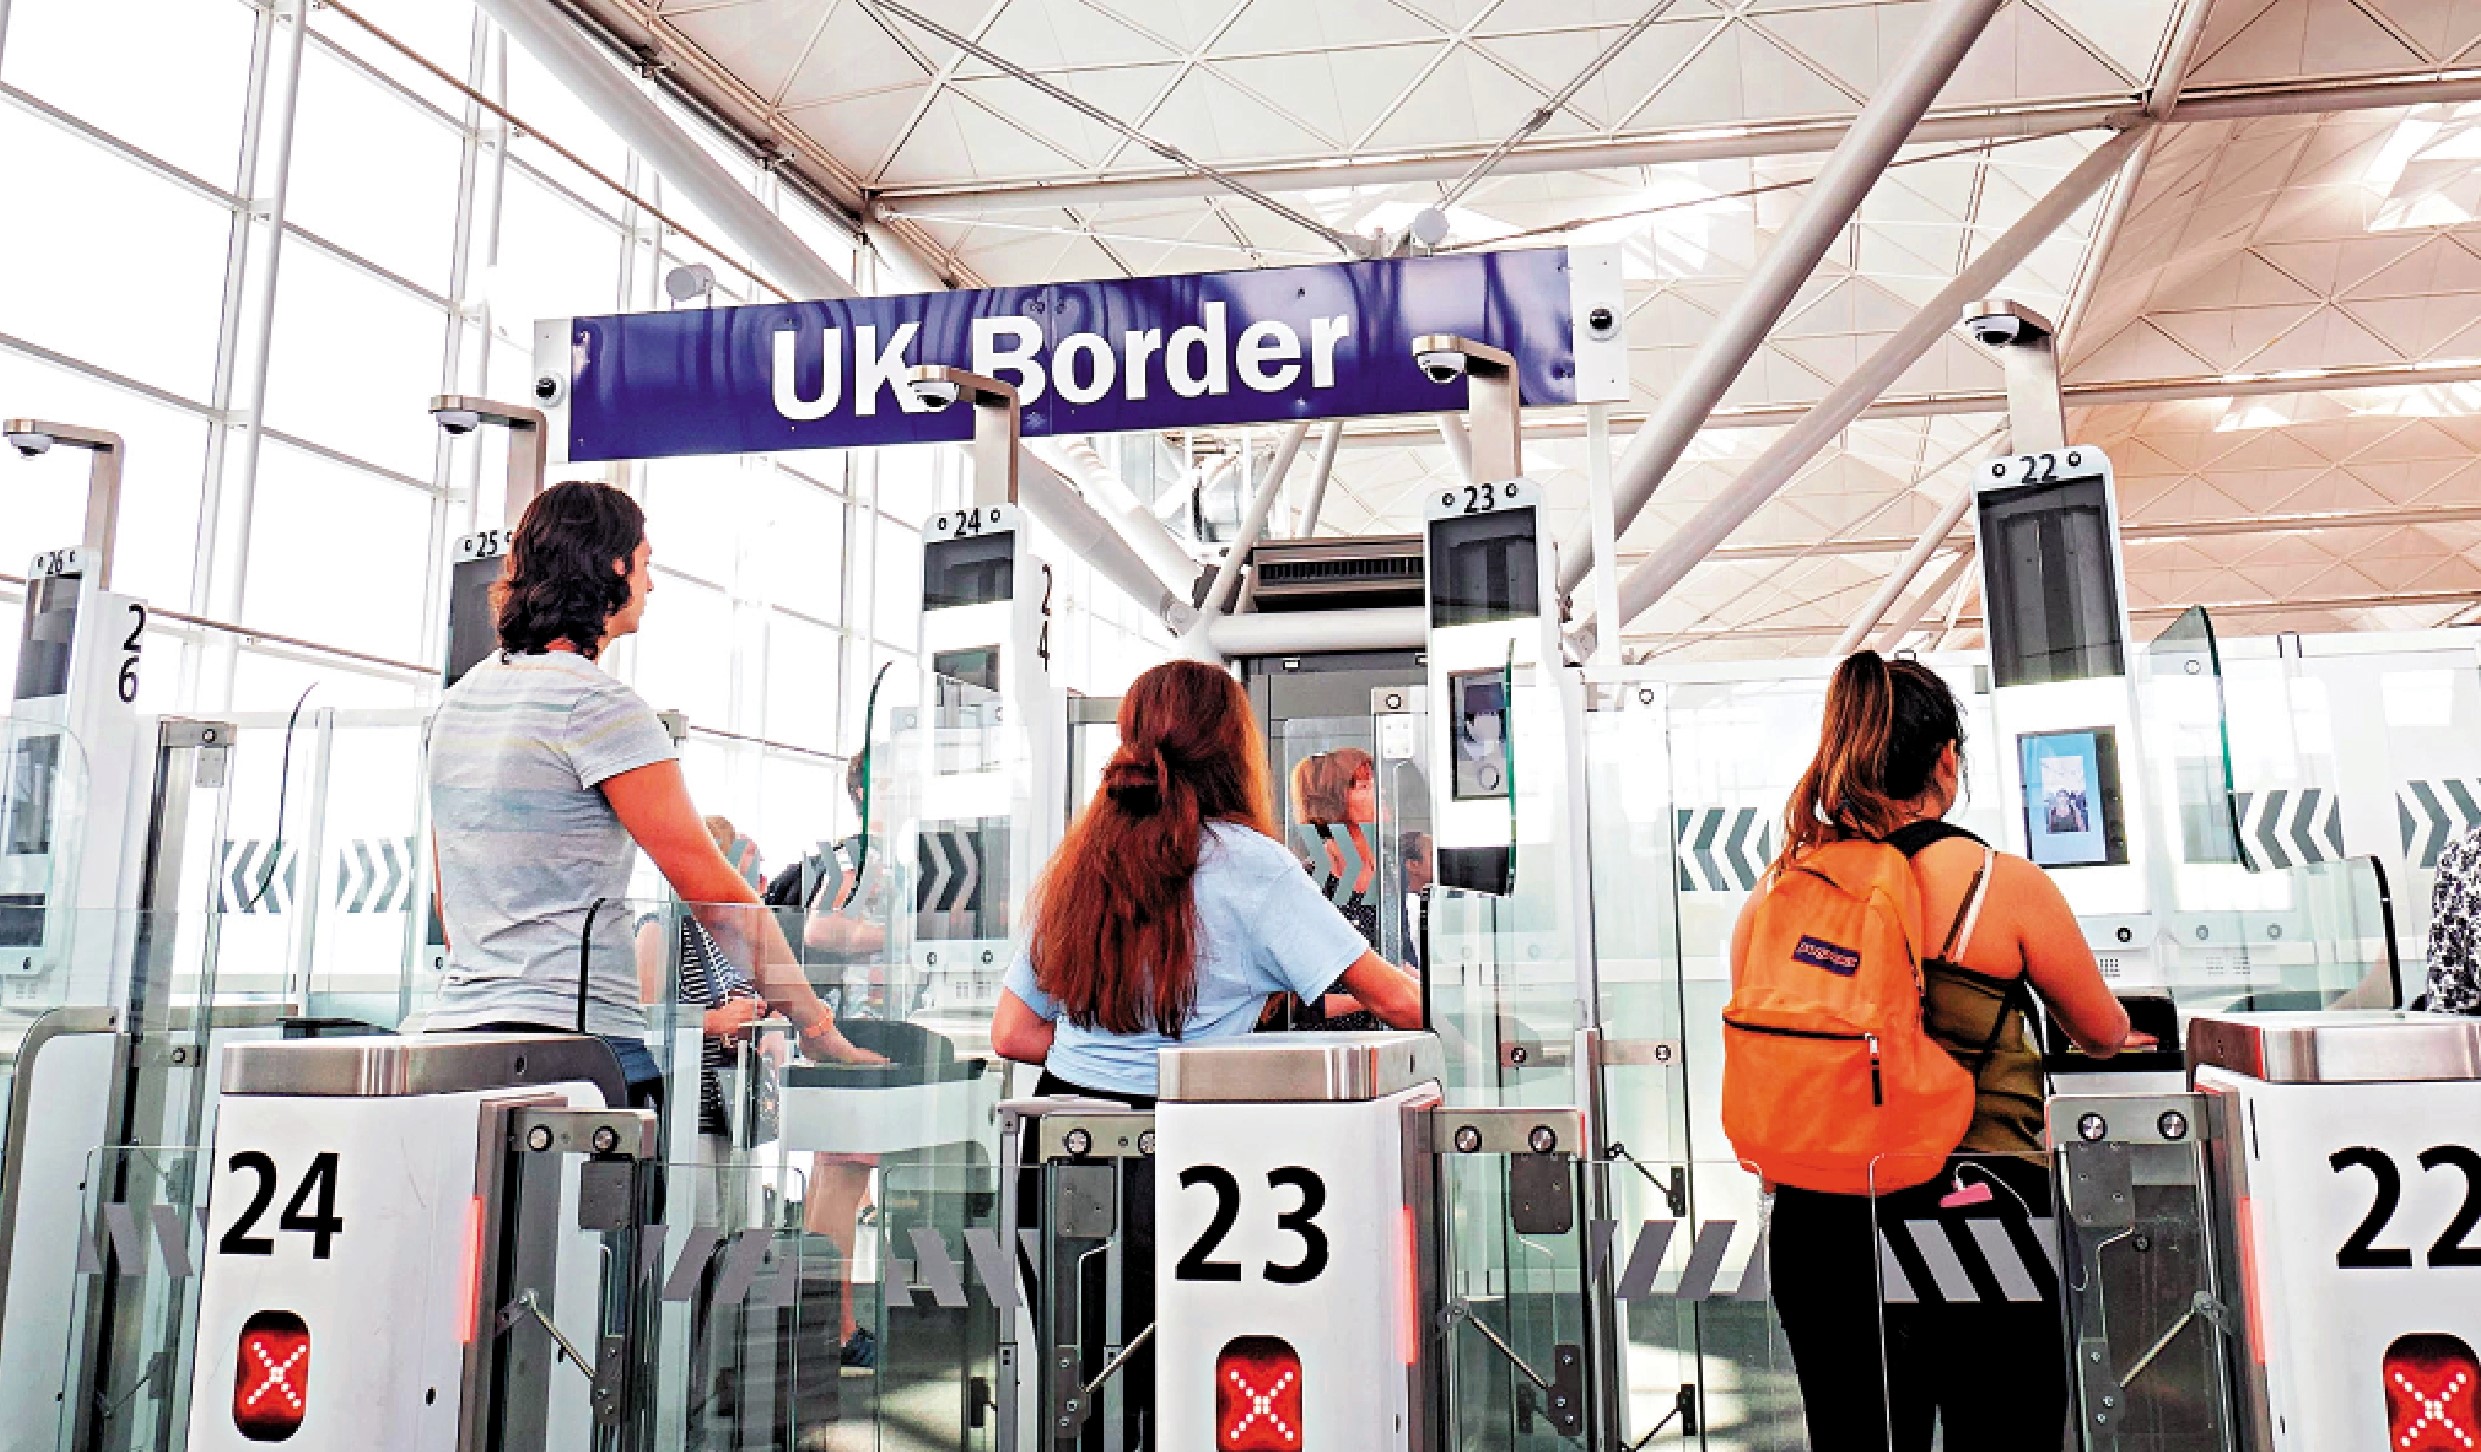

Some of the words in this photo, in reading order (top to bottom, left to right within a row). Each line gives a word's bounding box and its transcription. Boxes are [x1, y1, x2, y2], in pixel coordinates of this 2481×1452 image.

[771, 322, 932, 421] UK
[971, 301, 1349, 409] Border
[1463, 483, 1495, 513] 23
[2020, 454, 2058, 483] 22
[476, 530, 498, 557] 25
[954, 508, 981, 535] 24
[219, 1150, 343, 1260] 24
[1174, 1164, 1330, 1286] 23
[2328, 1144, 2481, 1270] 22
